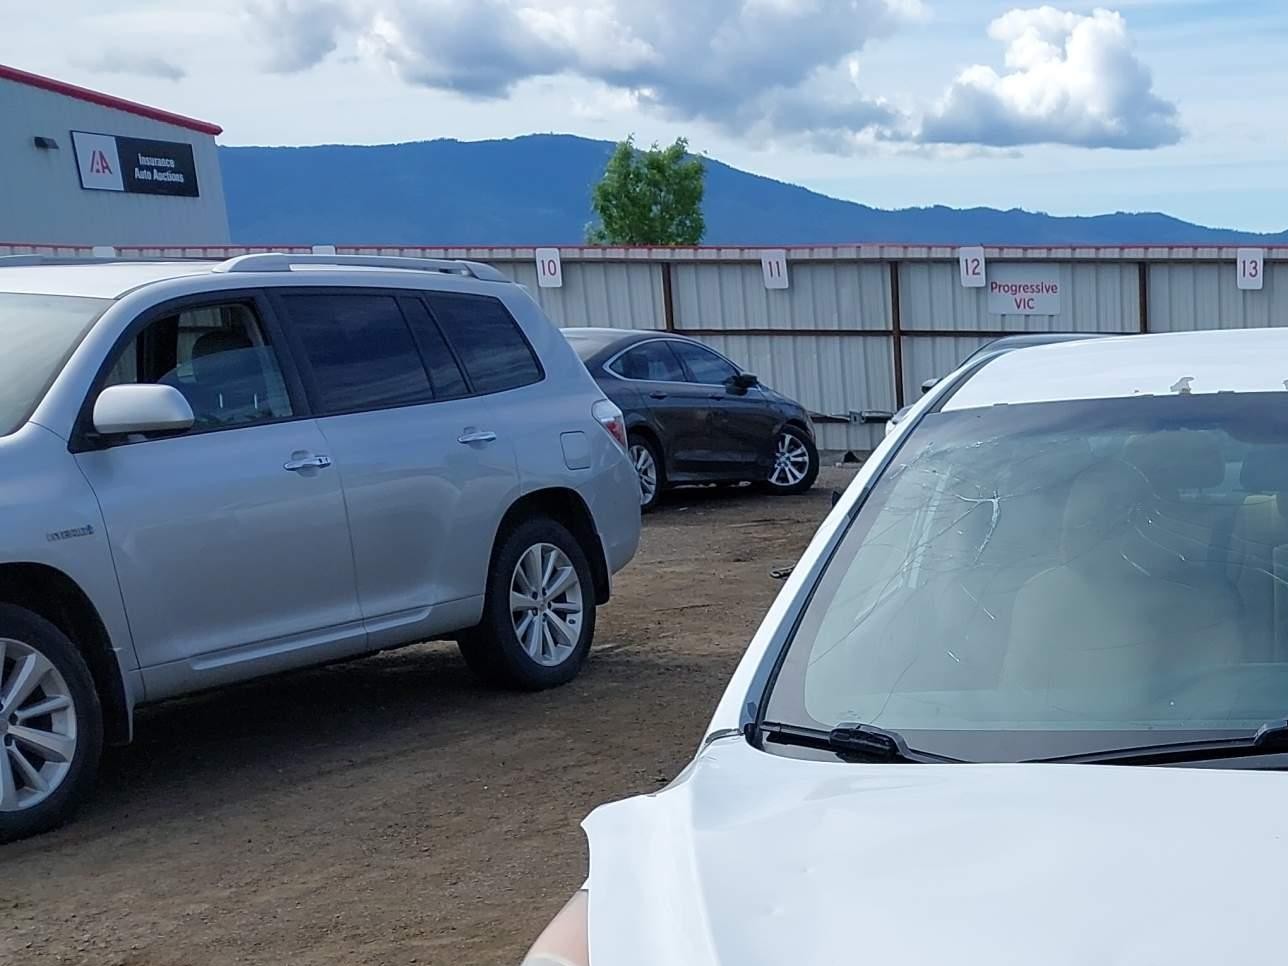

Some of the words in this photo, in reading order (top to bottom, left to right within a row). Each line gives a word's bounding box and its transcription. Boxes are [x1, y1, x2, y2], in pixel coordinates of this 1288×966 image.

[138, 153, 175, 168] Insurance
[135, 168, 152, 180] Auto
[153, 170, 184, 183] Auctions
[541, 259, 557, 277] 10
[768, 260, 781, 278] 11
[965, 258, 981, 276] 12
[1242, 259, 1258, 278] 13
[990, 281, 1058, 295] Progressive
[1014, 298, 1035, 309] VIC
